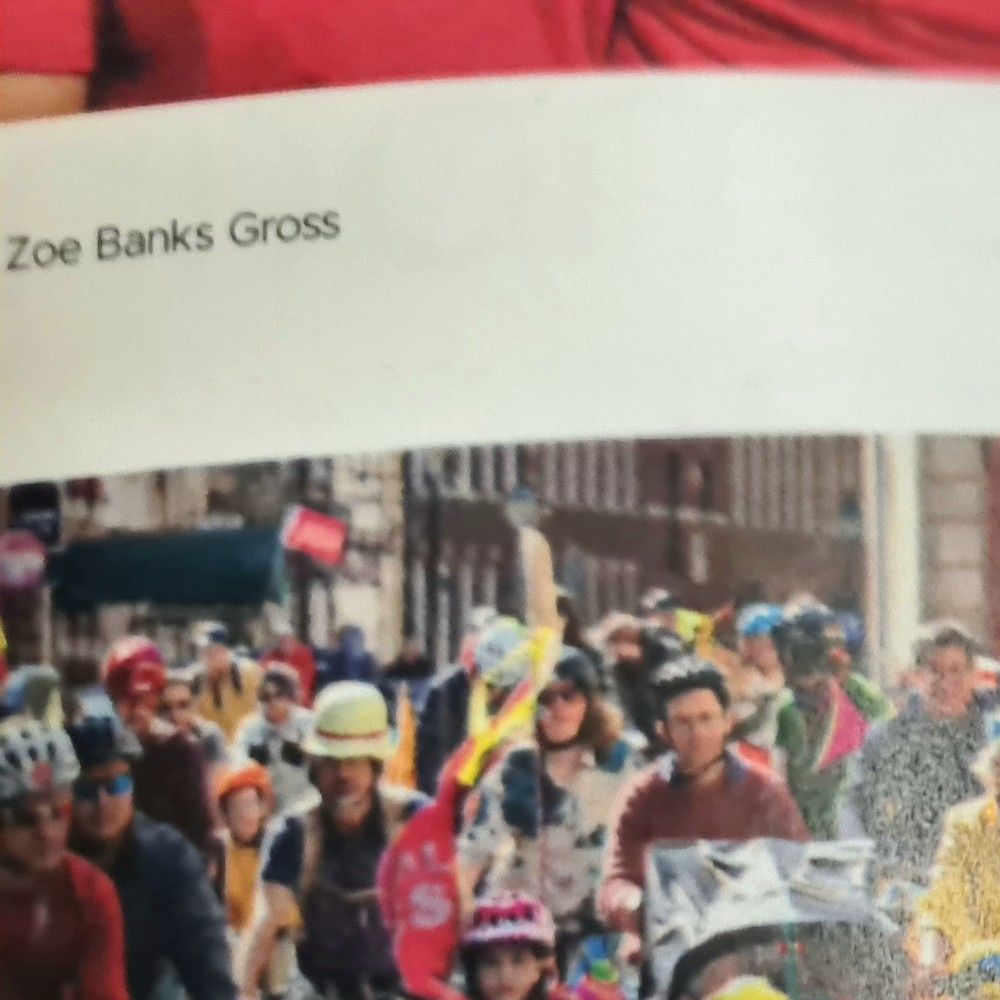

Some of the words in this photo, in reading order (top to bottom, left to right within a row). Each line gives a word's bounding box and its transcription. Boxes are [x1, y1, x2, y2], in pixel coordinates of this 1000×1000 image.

[7, 235, 82, 271] Zoe
[96, 219, 215, 261] Banks
[229, 211, 341, 247] Gross
